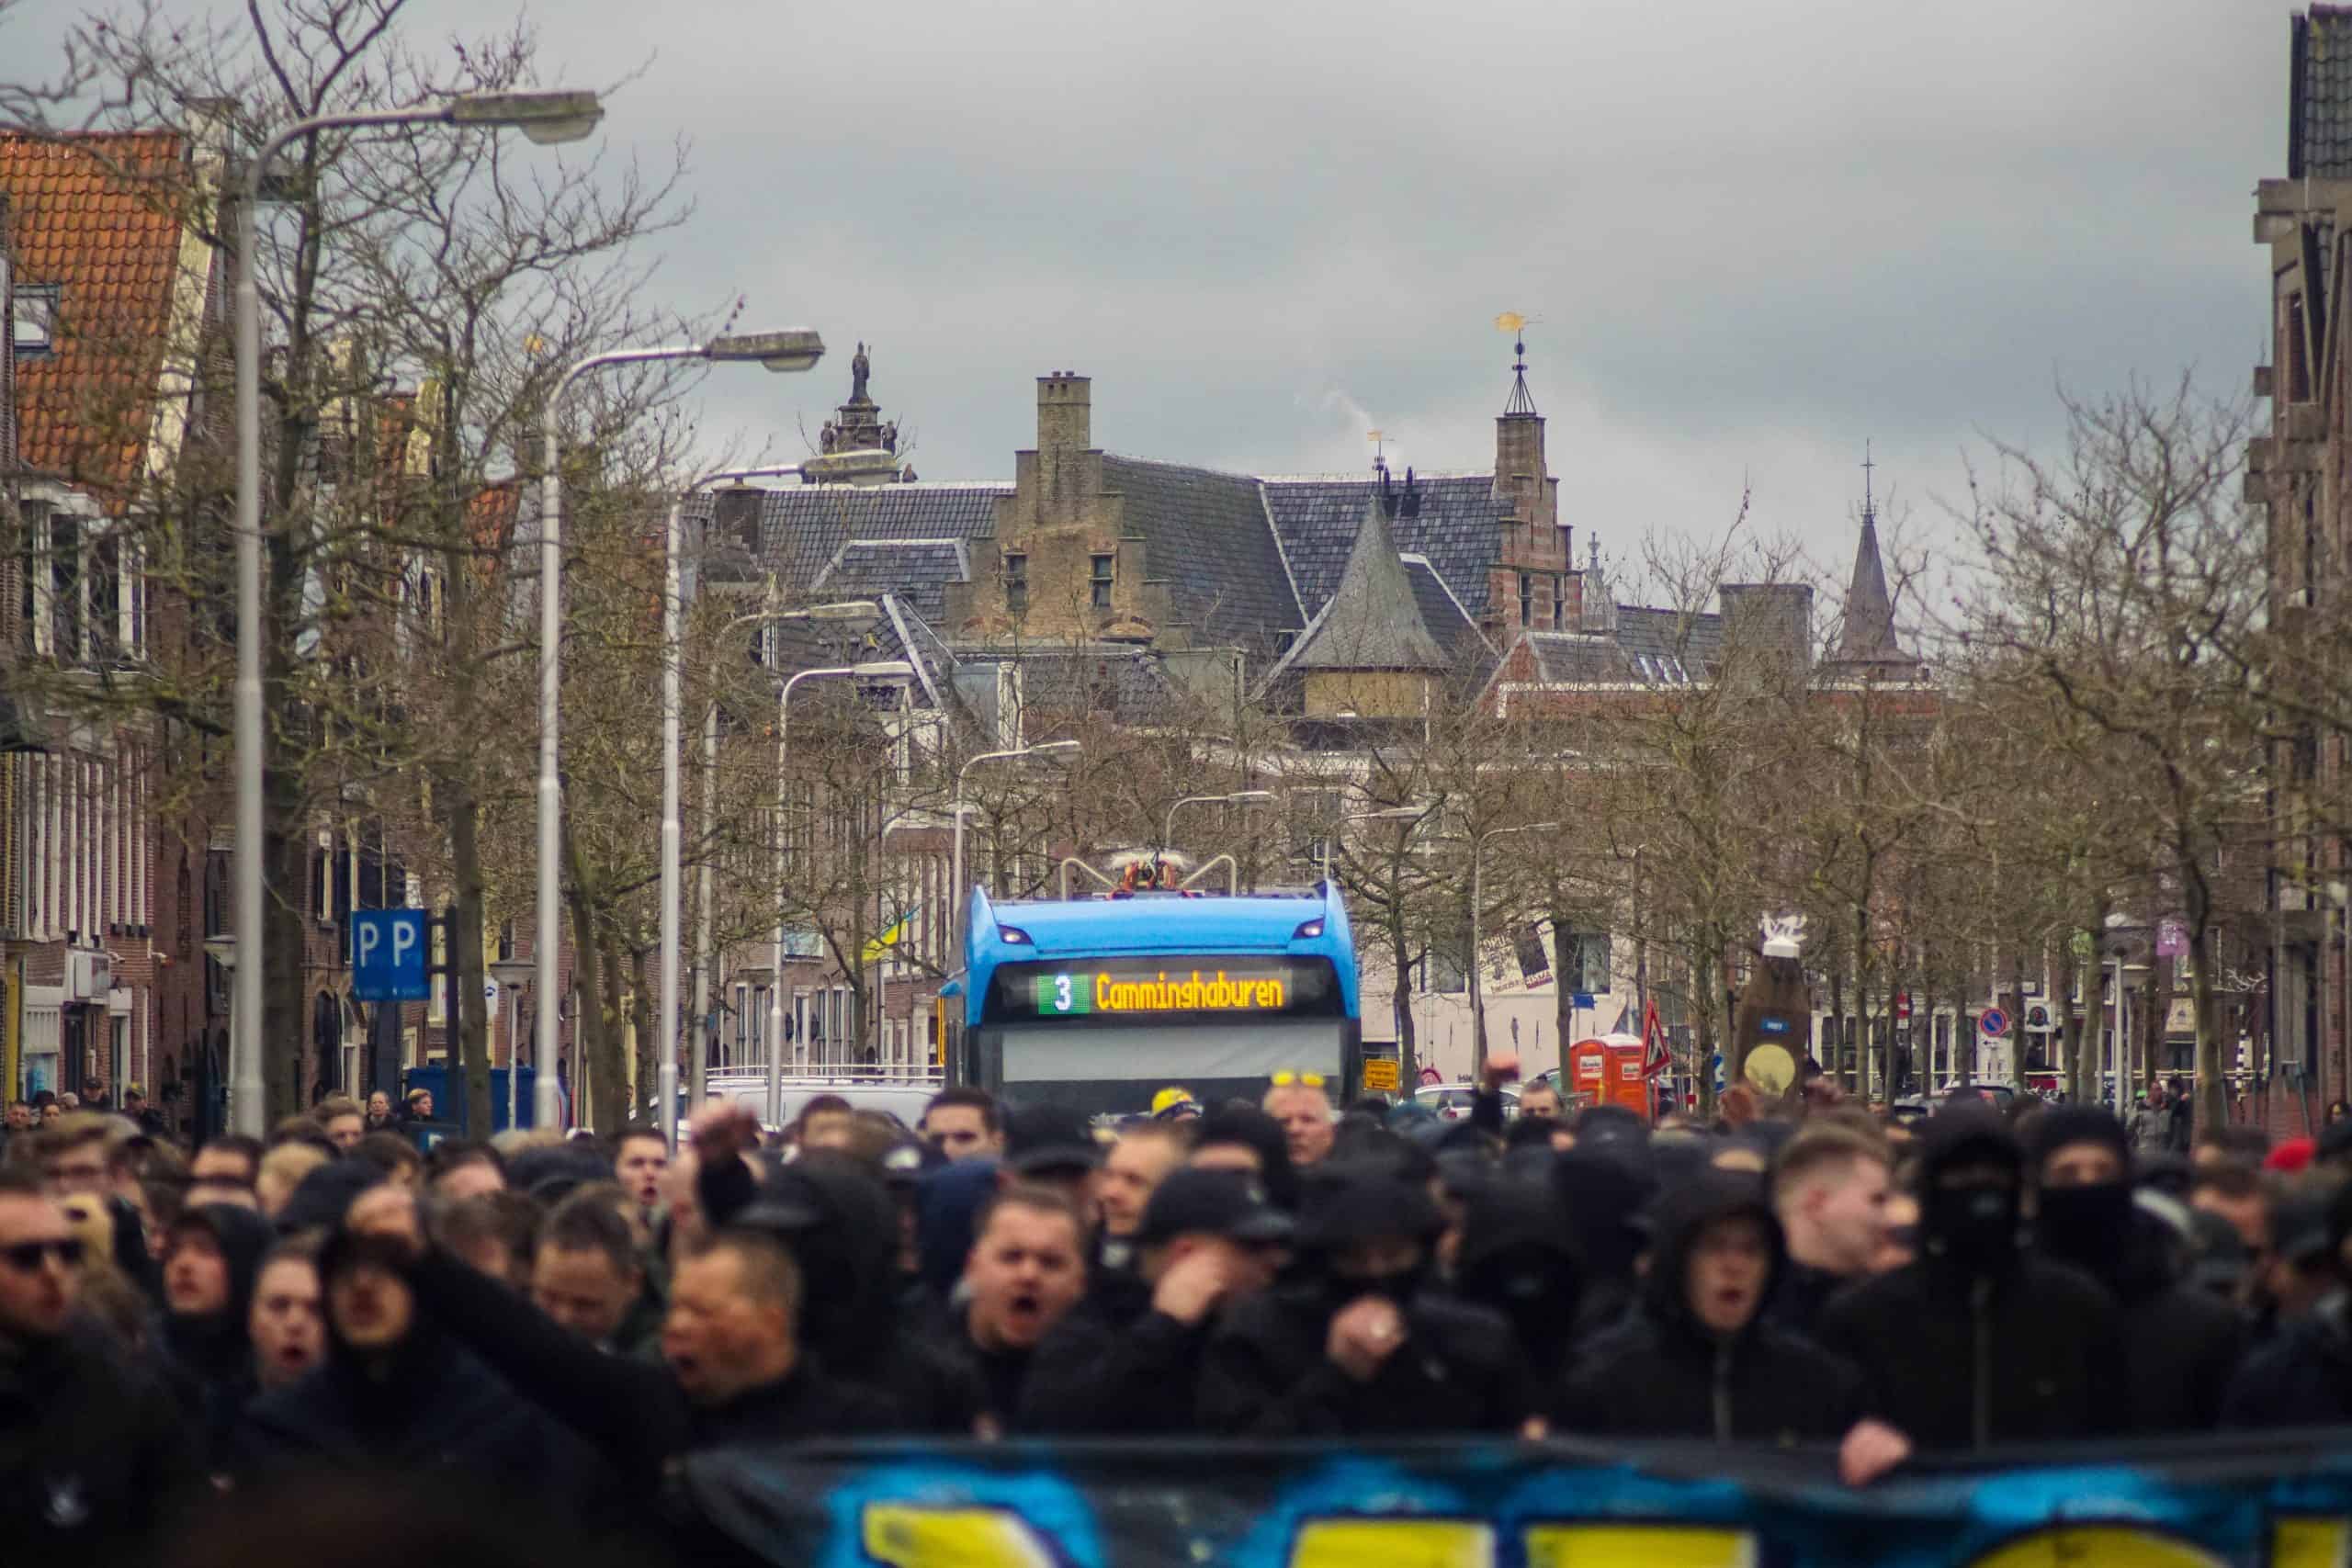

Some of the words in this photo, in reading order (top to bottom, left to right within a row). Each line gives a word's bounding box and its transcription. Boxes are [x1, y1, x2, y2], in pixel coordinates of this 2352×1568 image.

[359, 921, 379, 967] P
[392, 921, 415, 967] P
[1055, 975, 1071, 1010] 3
